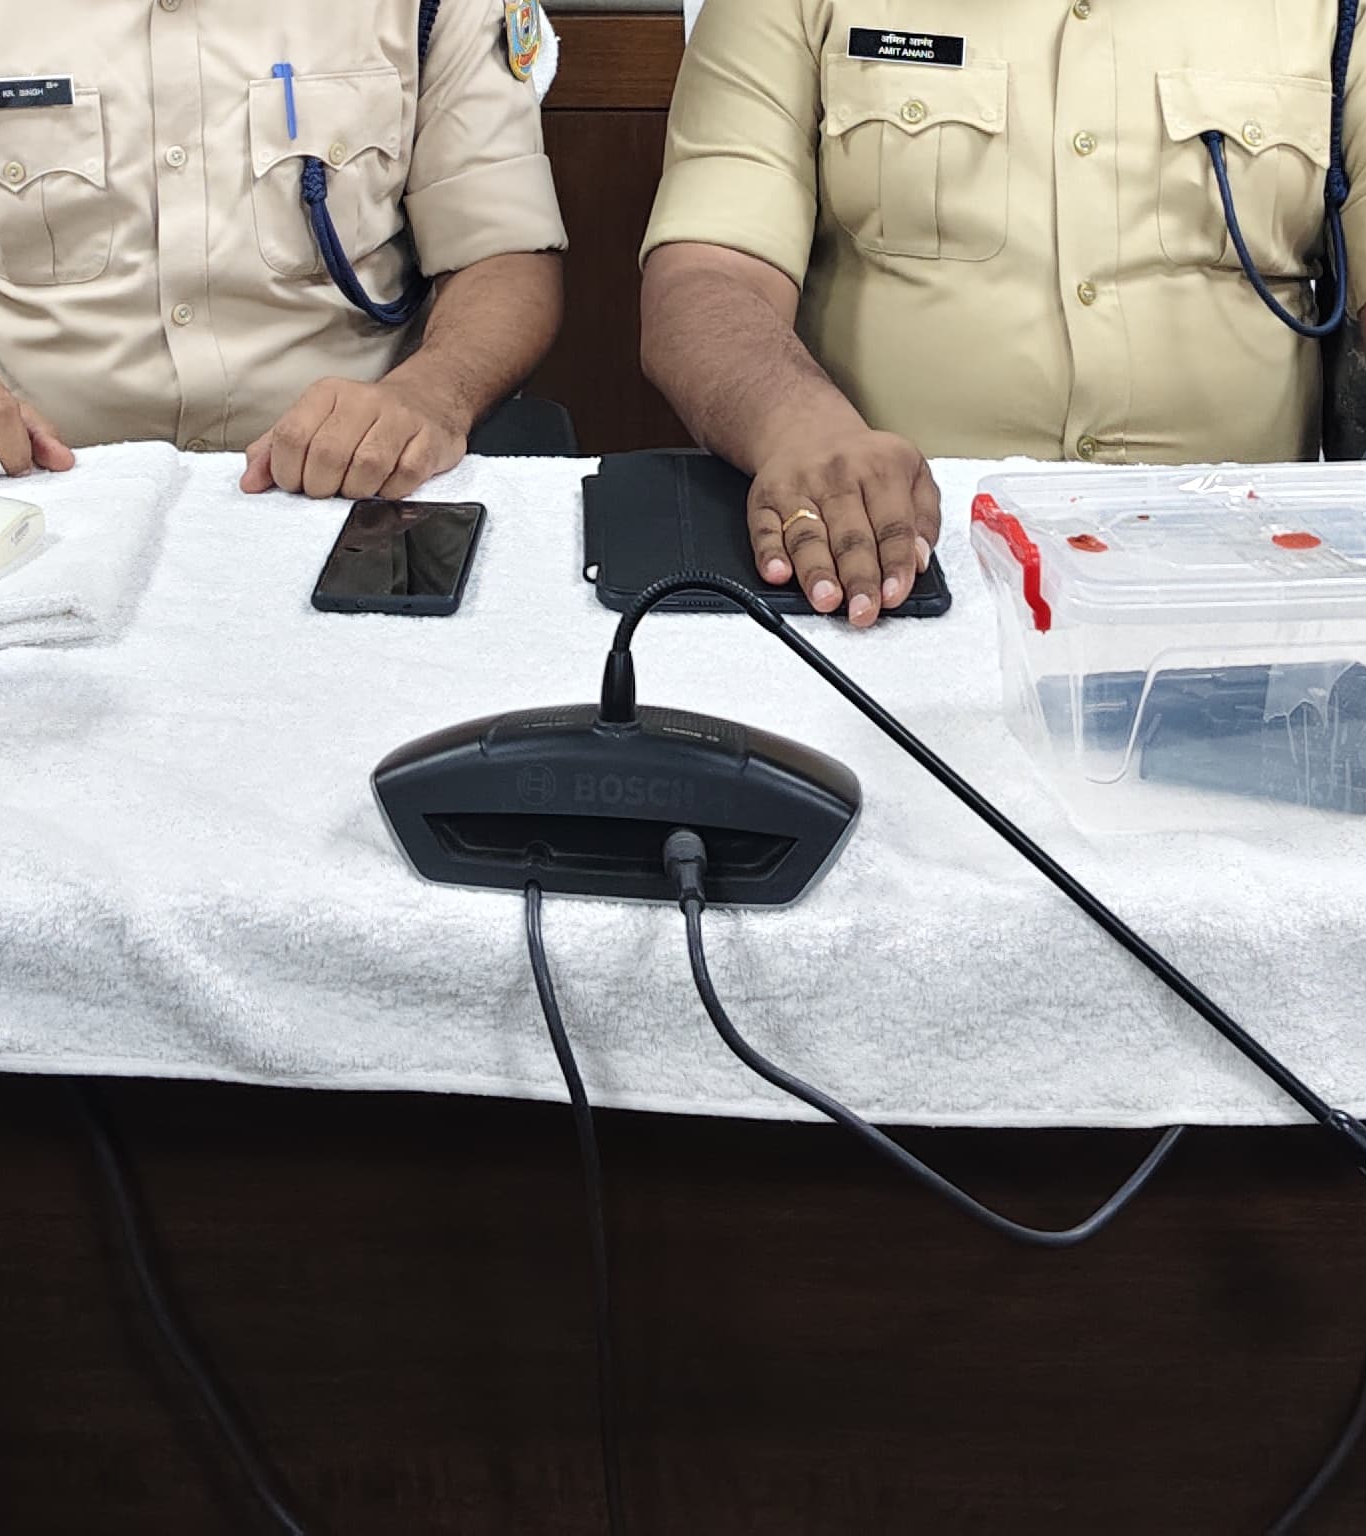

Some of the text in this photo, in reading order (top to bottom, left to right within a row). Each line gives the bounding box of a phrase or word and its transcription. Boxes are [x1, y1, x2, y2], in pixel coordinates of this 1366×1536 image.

[878, 46, 935, 59] AMIT ANAND
[574, 772, 696, 808] BOSCH
